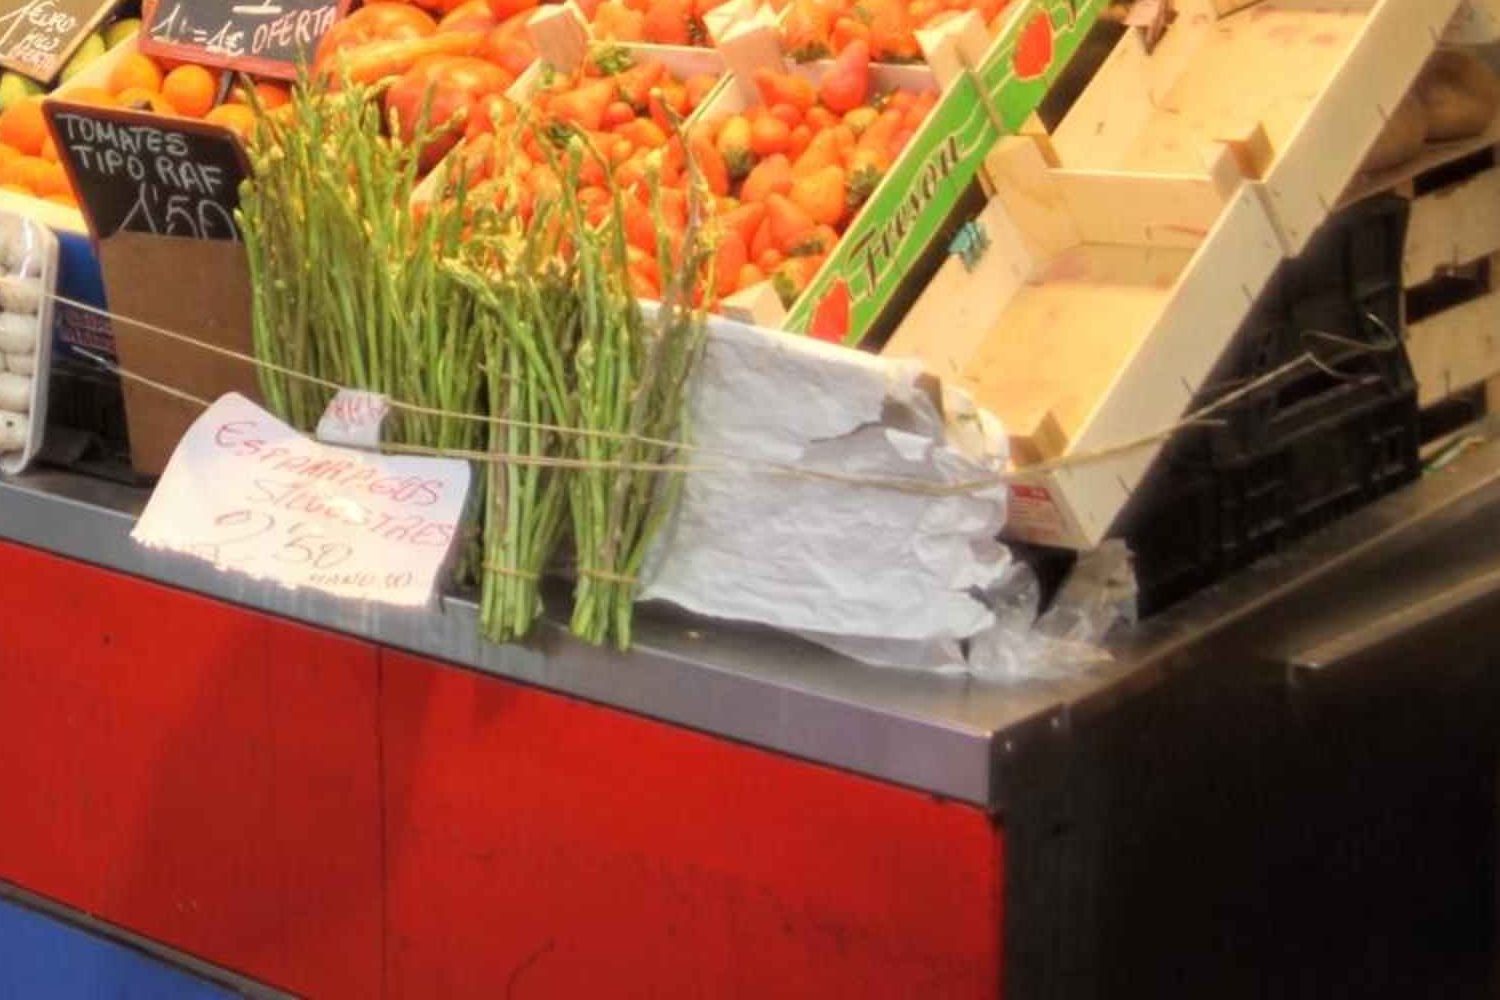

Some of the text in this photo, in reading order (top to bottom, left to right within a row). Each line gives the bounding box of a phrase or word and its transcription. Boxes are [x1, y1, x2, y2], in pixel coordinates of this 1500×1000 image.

[251, 5, 338, 53] OFERTA
[55, 112, 189, 157] TOMATES
[70, 144, 223, 195] TIPO RAF
